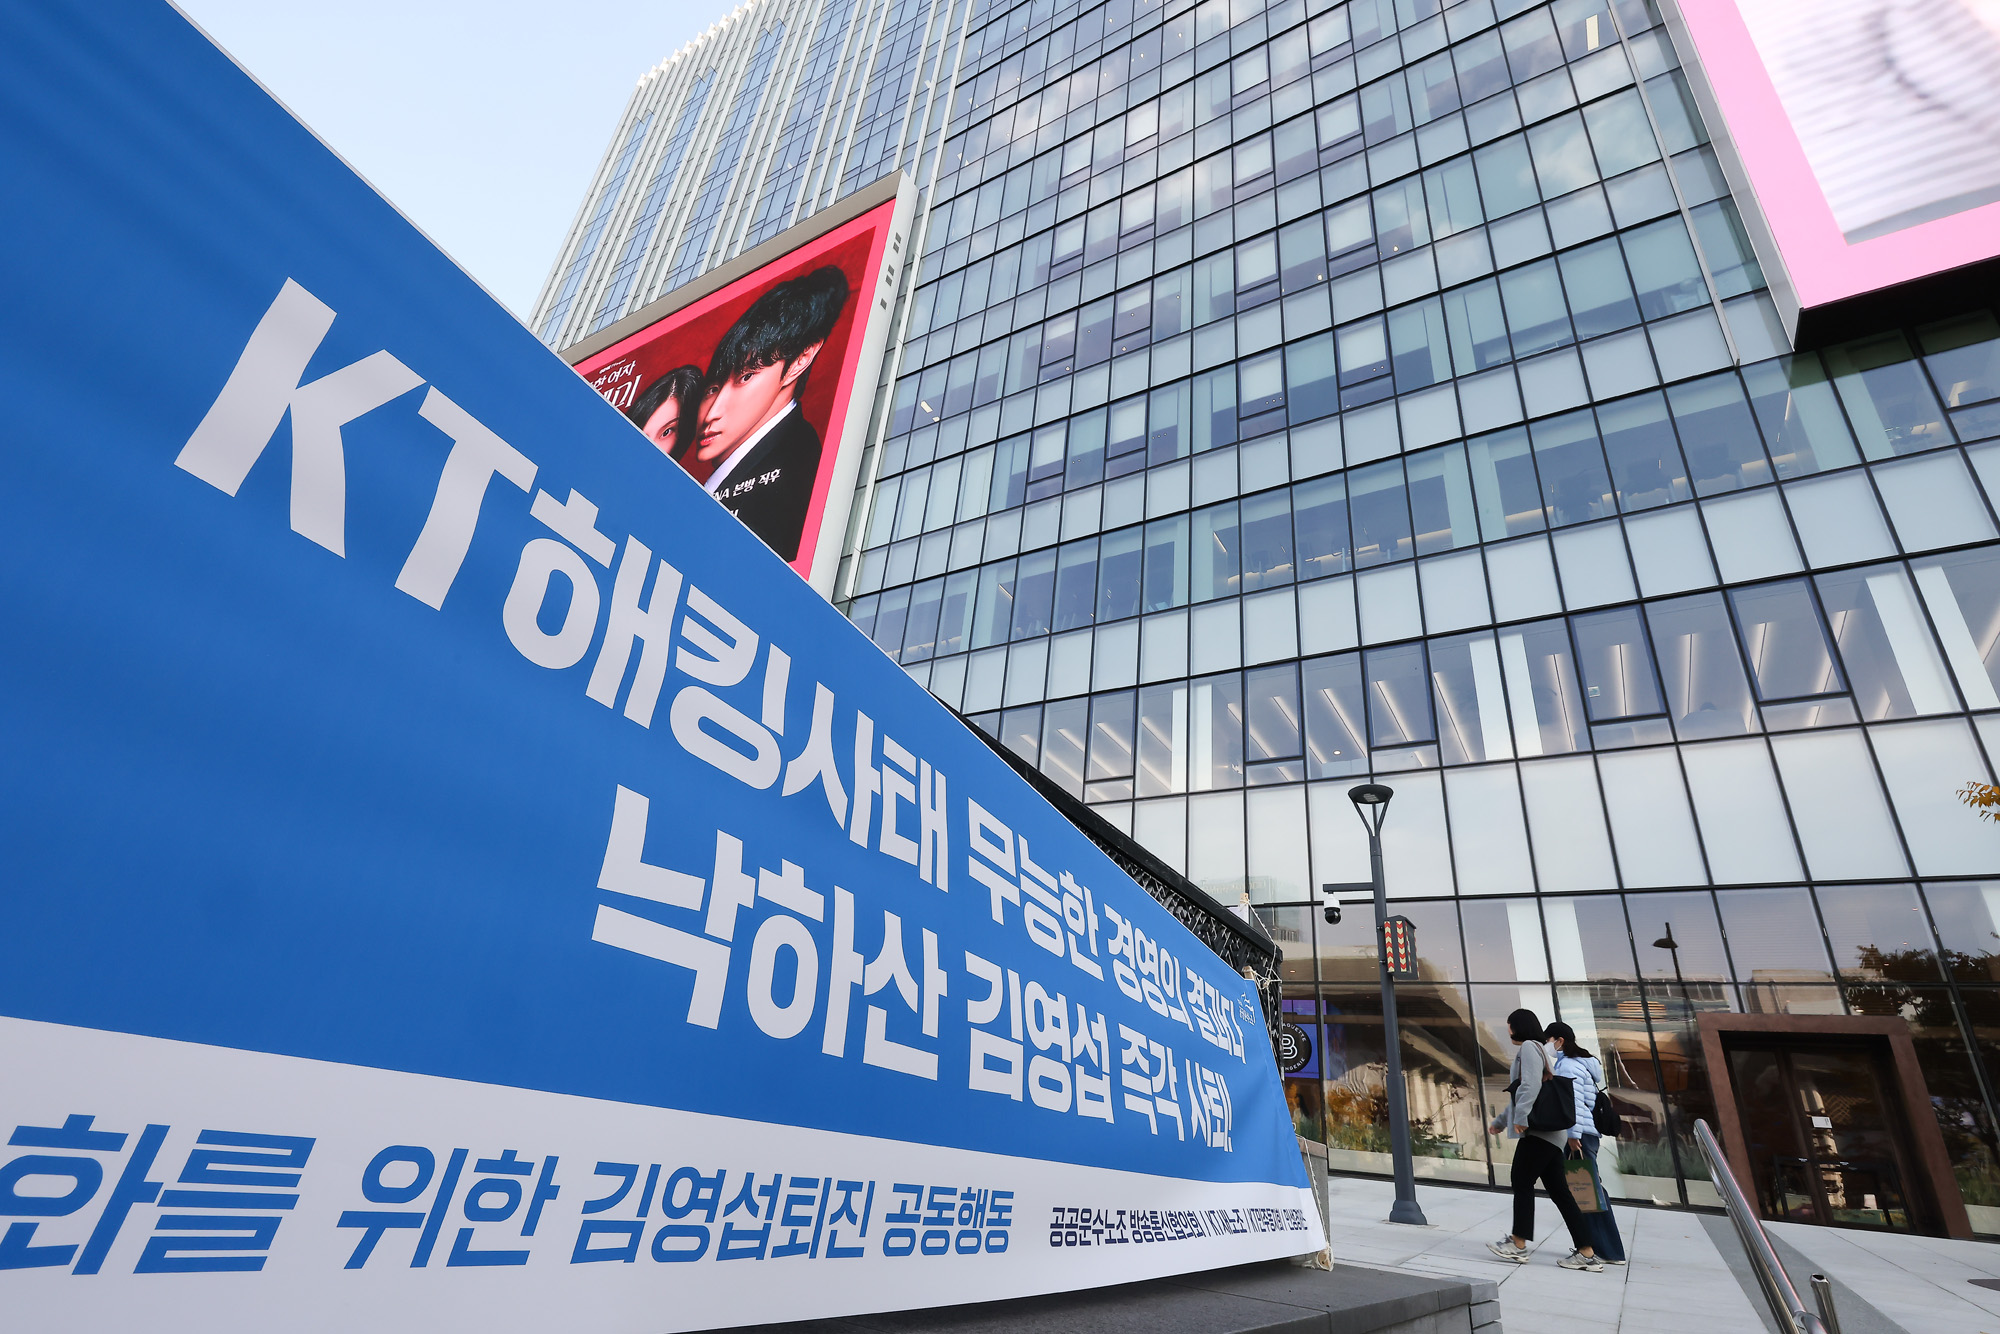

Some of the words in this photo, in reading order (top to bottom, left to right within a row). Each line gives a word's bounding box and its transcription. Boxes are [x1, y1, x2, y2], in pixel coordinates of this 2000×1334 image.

[607, 360, 636, 384] 여자
[713, 487, 730, 501] NA
[732, 477, 757, 497] 본방
[758, 468, 782, 486] 직후
[173, 277, 949, 892] KT해킹사태
[967, 797, 1104, 982] 무능한
[1103, 902, 1195, 1033] 경영의
[1185, 966, 1247, 1065] 결과다
[591, 783, 948, 1081] 낙하산
[965, 950, 1114, 1125] 김영섭
[1117, 1022, 1185, 1142] 즉각
[1185, 1058, 1234, 1153] 사퇴!
[0, 1113, 317, 1275] 화를
[336, 1144, 561, 1270] 위한
[570, 1161, 876, 1265] 김영섭퇴진
[882, 1182, 1015, 1257] 공동행동
[1049, 1206, 1130, 1248] 공공운수노조
[1129, 1209, 1205, 1244] 방송통신협의회
